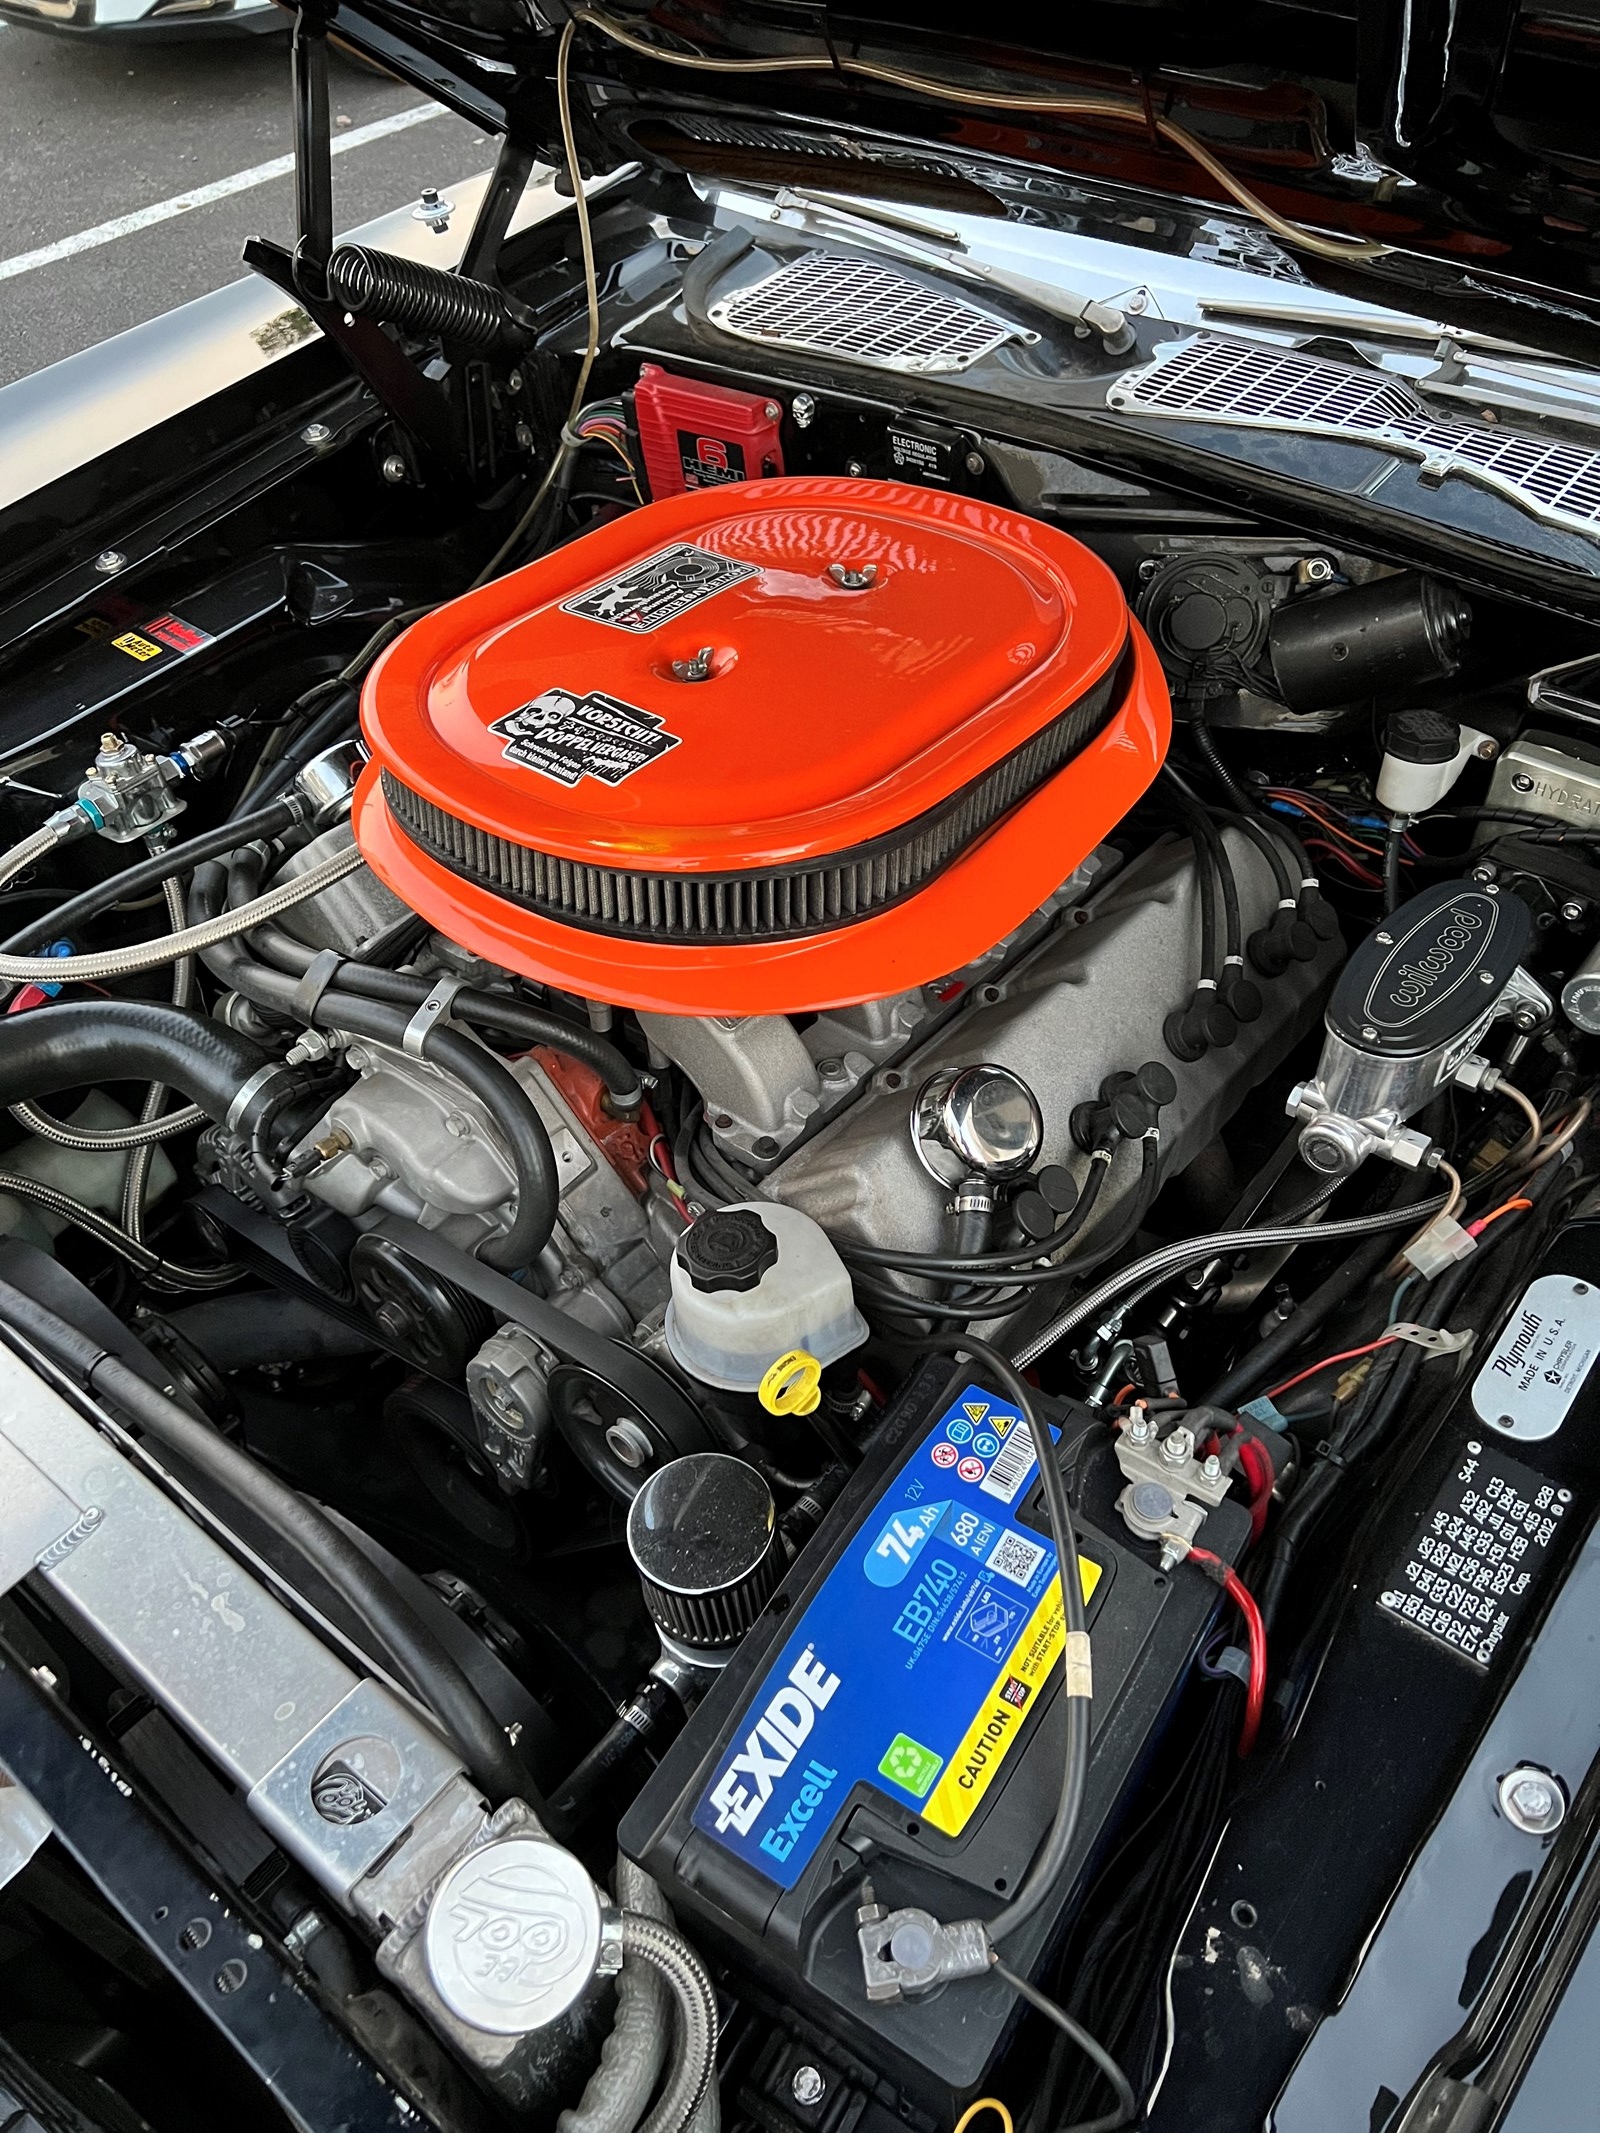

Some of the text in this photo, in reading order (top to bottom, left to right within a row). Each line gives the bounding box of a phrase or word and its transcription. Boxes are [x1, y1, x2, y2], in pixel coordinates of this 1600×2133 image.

[682, 456, 745, 481] HEMI
[696, 437, 728, 473] 6
[892, 435, 937, 456] ELECTRONIC
[534, 727, 649, 764] DOPPELVERGASER!
[576, 704, 663, 745] VORSICHT!
[509, 744, 579, 781] durch kleinen Abstand!
[558, 755, 582, 770] Folgen
[1390, 907, 1482, 1007] wilwood
[1492, 1310, 1543, 1377] Plymouth
[1518, 1363, 1539, 1392] MADE
[1535, 1349, 1547, 1361] IN
[1553, 1340, 1574, 1370] CHRYSLER
[904, 1478, 925, 1501] 12V
[876, 1506, 940, 1565] 74 Ah
[950, 1512, 979, 1547] 680
[1405, 1561, 1424, 1582] J21
[1417, 1536, 1436, 1560] J25
[1431, 1510, 1450, 1535] J45
[1458, 1459, 1479, 1483] S44
[1534, 1517, 1557, 1547] 2012
[1402, 1490, 1480, 1618] B51 B41 B25 A24 A32
[1416, 1476, 1505, 1627] R11 G33 M21 A45 A62 C13
[1431, 1486, 1518, 1634] C16 C22 C56 C93 J11 D84
[1446, 1499, 1531, 1644] F12 F23 F96 H31 G11 G31
[892, 1558, 958, 1645] EB740
[1460, 1624, 1484, 1653] E74
[1475, 1595, 1498, 1623] D24
[1523, 1511, 1542, 1533] 415
[1019, 1657, 1032, 1672] NOT
[1027, 1624, 1050, 1657] SUITABLE
[1045, 1614, 1056, 1625] for
[1027, 1620, 1062, 1676] with START-STOP
[709, 1650, 841, 1837] EXIDE
[958, 1709, 1011, 1790] CAUTION
[759, 1759, 838, 1863] Excell
